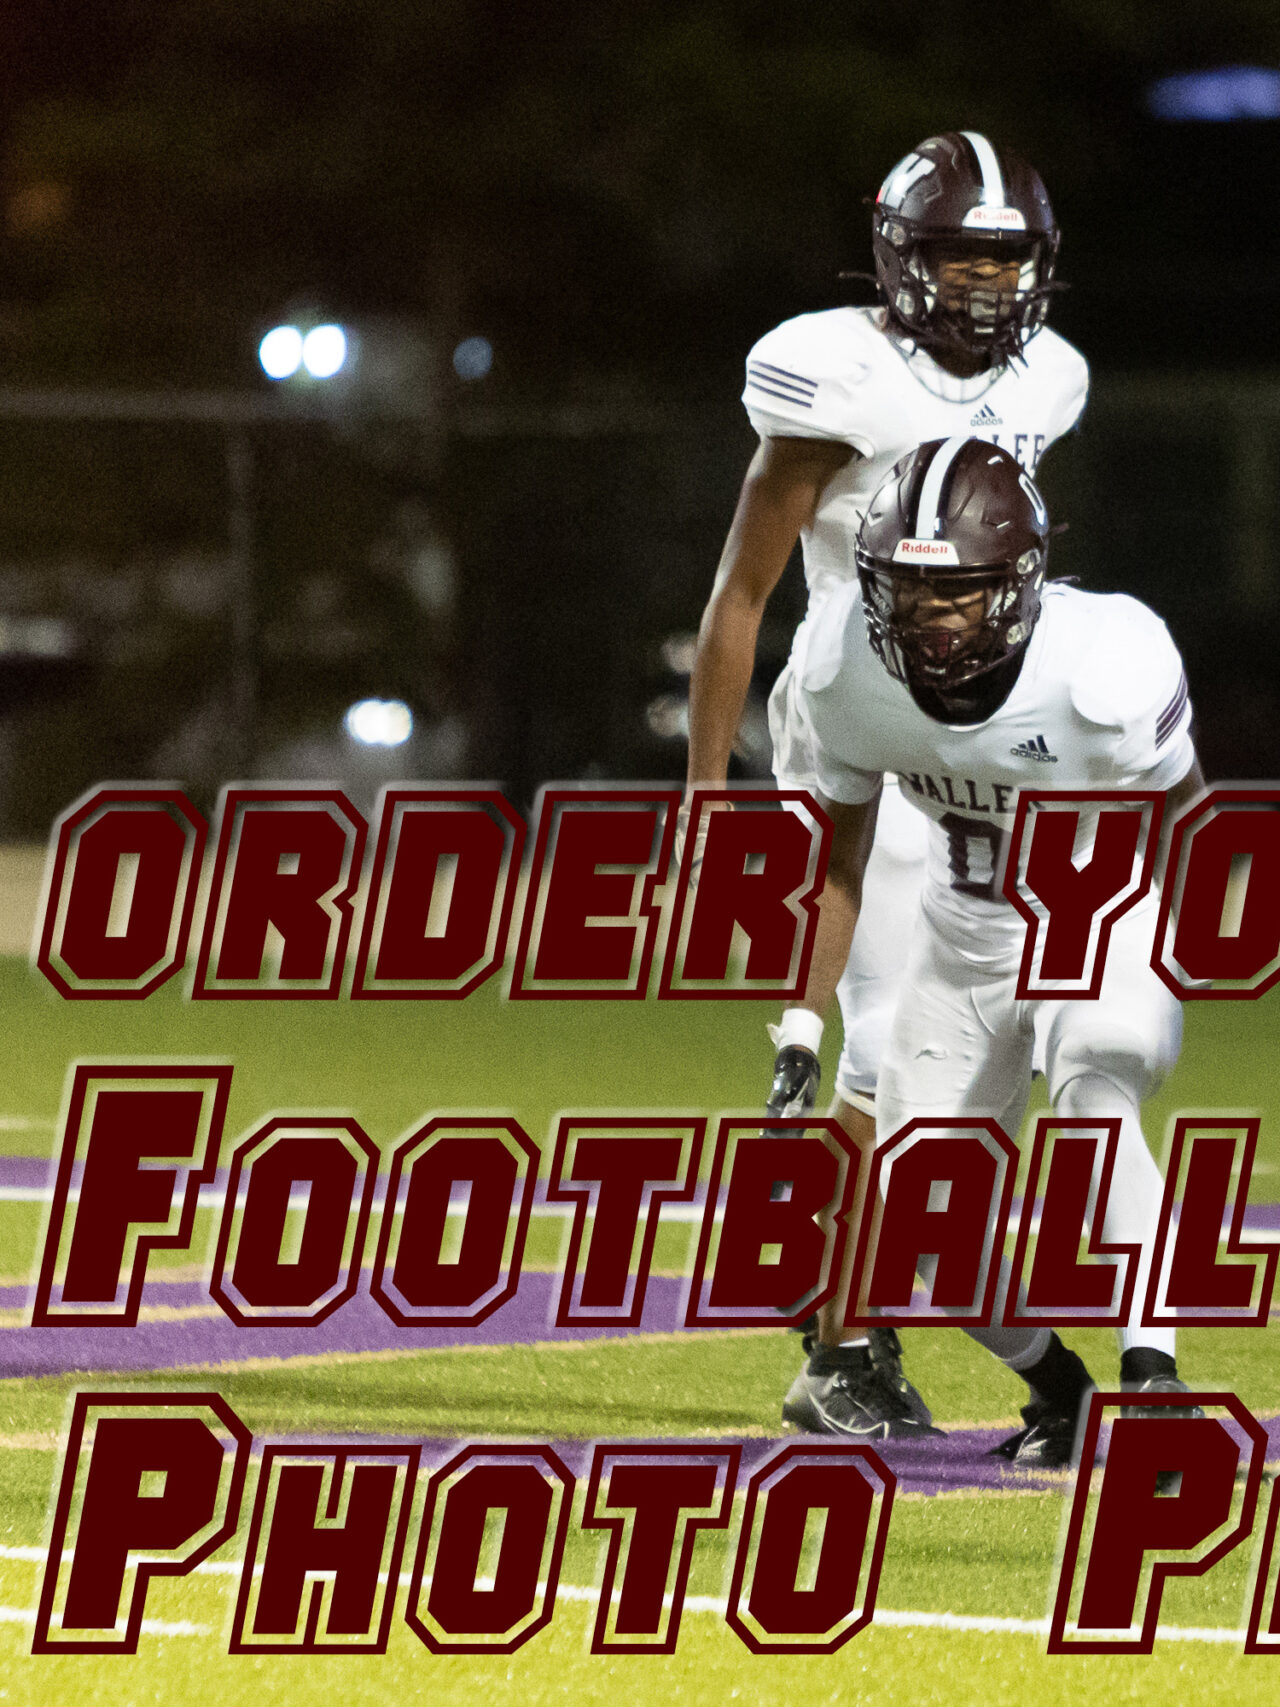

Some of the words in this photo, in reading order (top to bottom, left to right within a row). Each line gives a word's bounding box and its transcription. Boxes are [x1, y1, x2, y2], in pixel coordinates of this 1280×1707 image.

[973, 211, 1018, 221] Riell
[901, 542, 948, 554] Riddell
[1010, 747, 1058, 763] adidas
